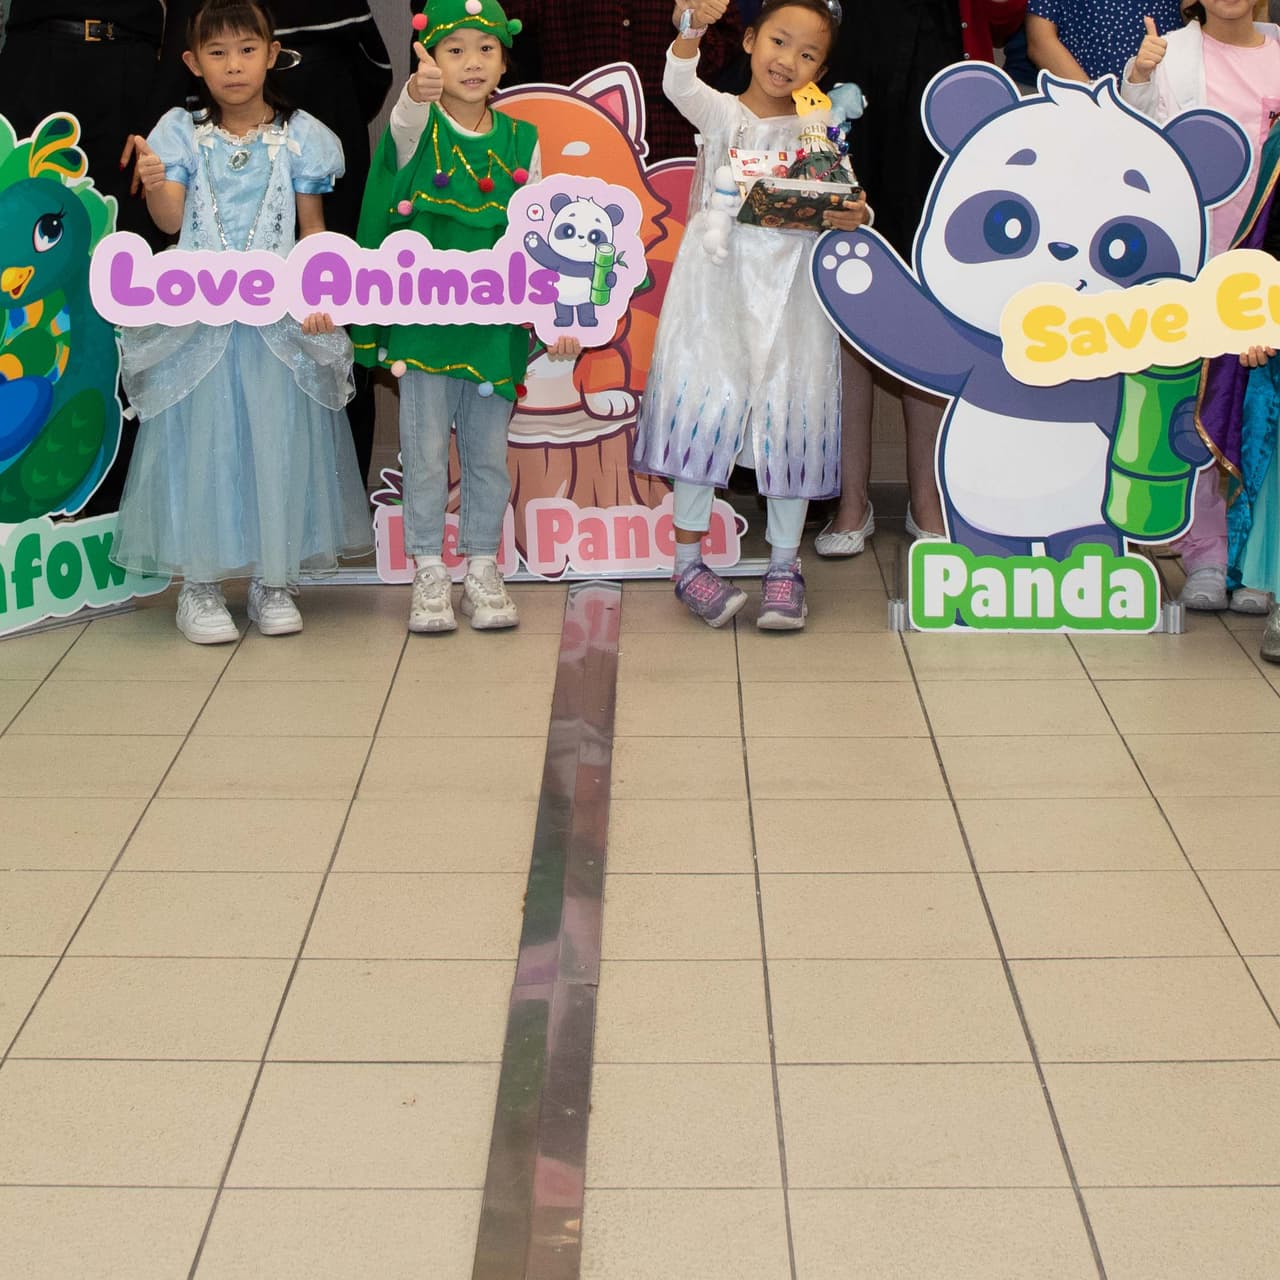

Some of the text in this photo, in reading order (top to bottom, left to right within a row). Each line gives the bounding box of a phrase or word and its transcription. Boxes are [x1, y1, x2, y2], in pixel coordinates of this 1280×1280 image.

[110, 249, 561, 307] Love Animals
[1022, 304, 1189, 363] Save
[923, 554, 1145, 618] Panda
